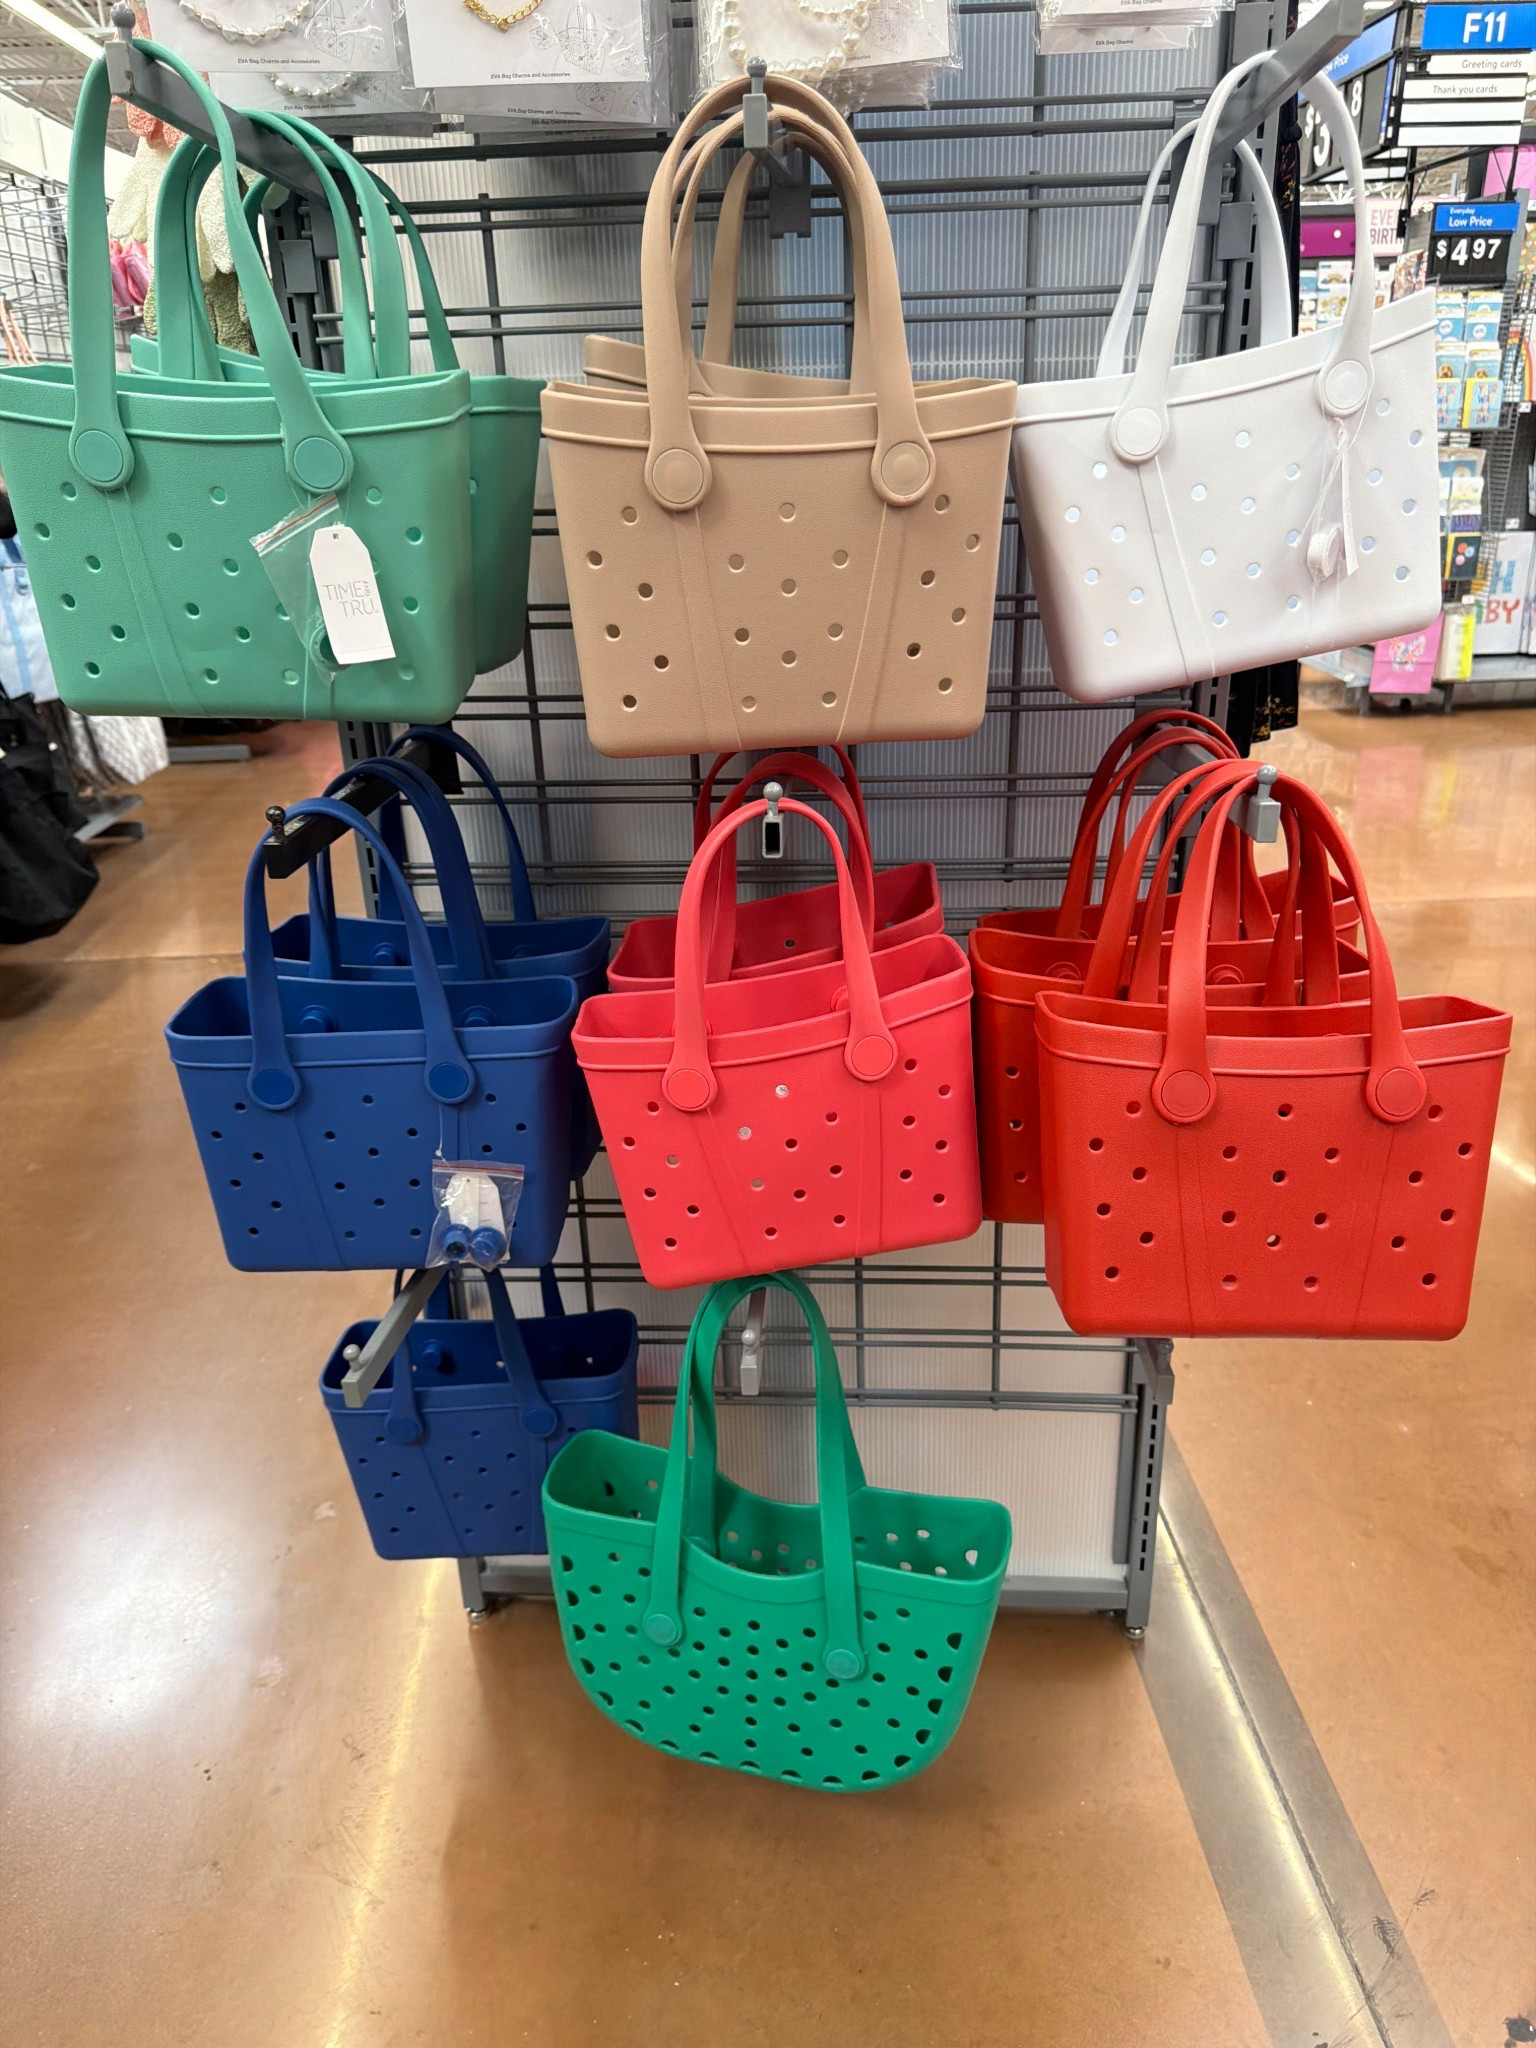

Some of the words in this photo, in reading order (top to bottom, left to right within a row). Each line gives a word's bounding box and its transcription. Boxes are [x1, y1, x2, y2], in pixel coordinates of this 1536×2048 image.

[1462, 11, 1507, 44] F11
[1461, 59, 1498, 71] Greeting
[1500, 59, 1522, 69] cards
[1433, 84, 1457, 95] Thank
[1459, 86, 1474, 96] you
[1476, 84, 1498, 94] cards
[1371, 208, 1399, 226] EVE
[1449, 207, 1475, 216] Everyday
[1448, 216, 1467, 227] Low
[1469, 215, 1493, 227] Price
[321, 580, 365, 601] TIME
[337, 597, 375, 618] TRU
